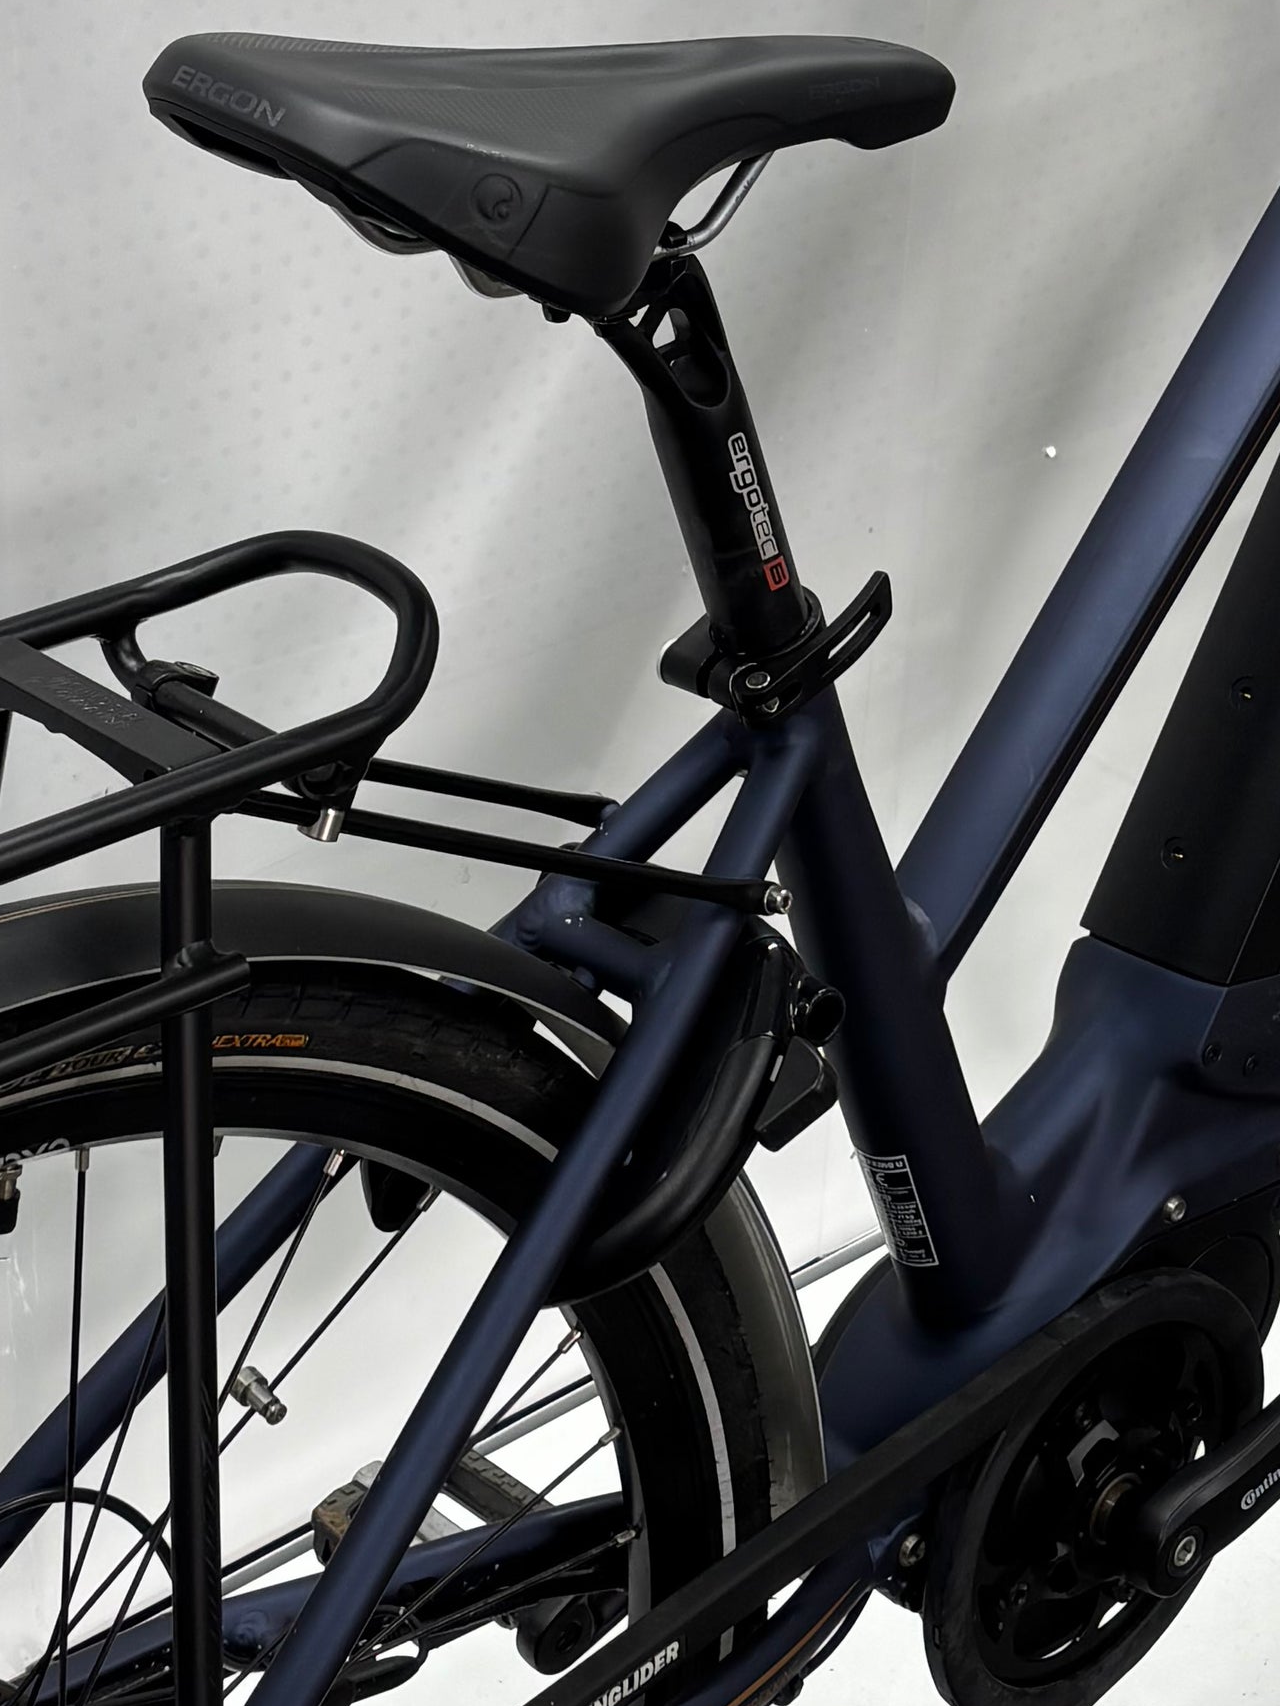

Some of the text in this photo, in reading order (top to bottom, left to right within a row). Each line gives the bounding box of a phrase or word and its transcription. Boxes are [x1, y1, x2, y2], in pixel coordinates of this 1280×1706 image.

[171, 65, 286, 127] ERGON
[809, 76, 881, 101] ERGON
[727, 431, 780, 562] ergotec
[217, 1033, 282, 1049] EXTRA
